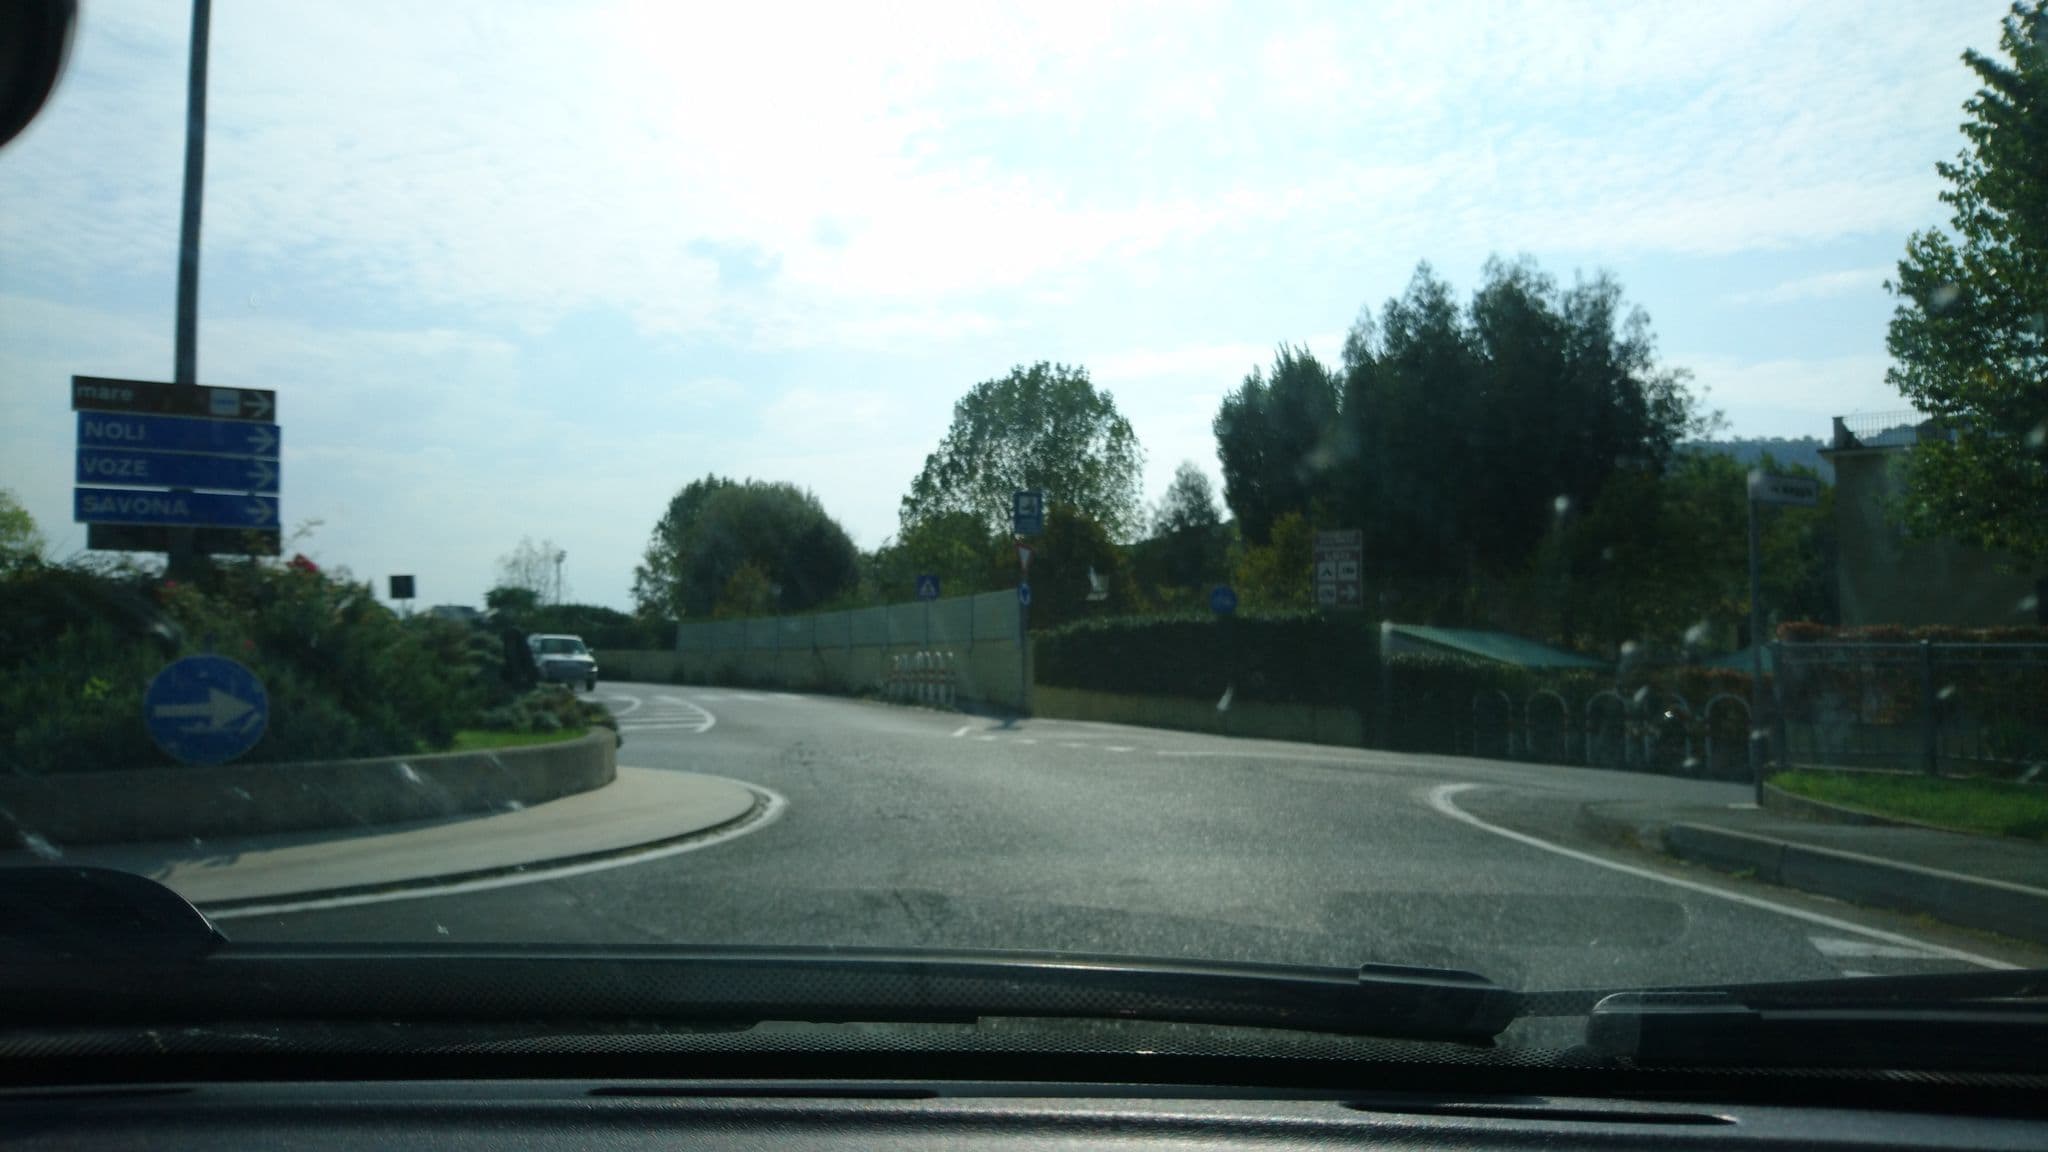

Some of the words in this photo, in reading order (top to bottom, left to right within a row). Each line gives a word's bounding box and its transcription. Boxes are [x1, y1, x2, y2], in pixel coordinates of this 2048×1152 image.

[76, 384, 134, 401] mare
[85, 421, 146, 441] NOLI
[83, 458, 149, 477] VOZE
[83, 495, 190, 515] SAVONA
